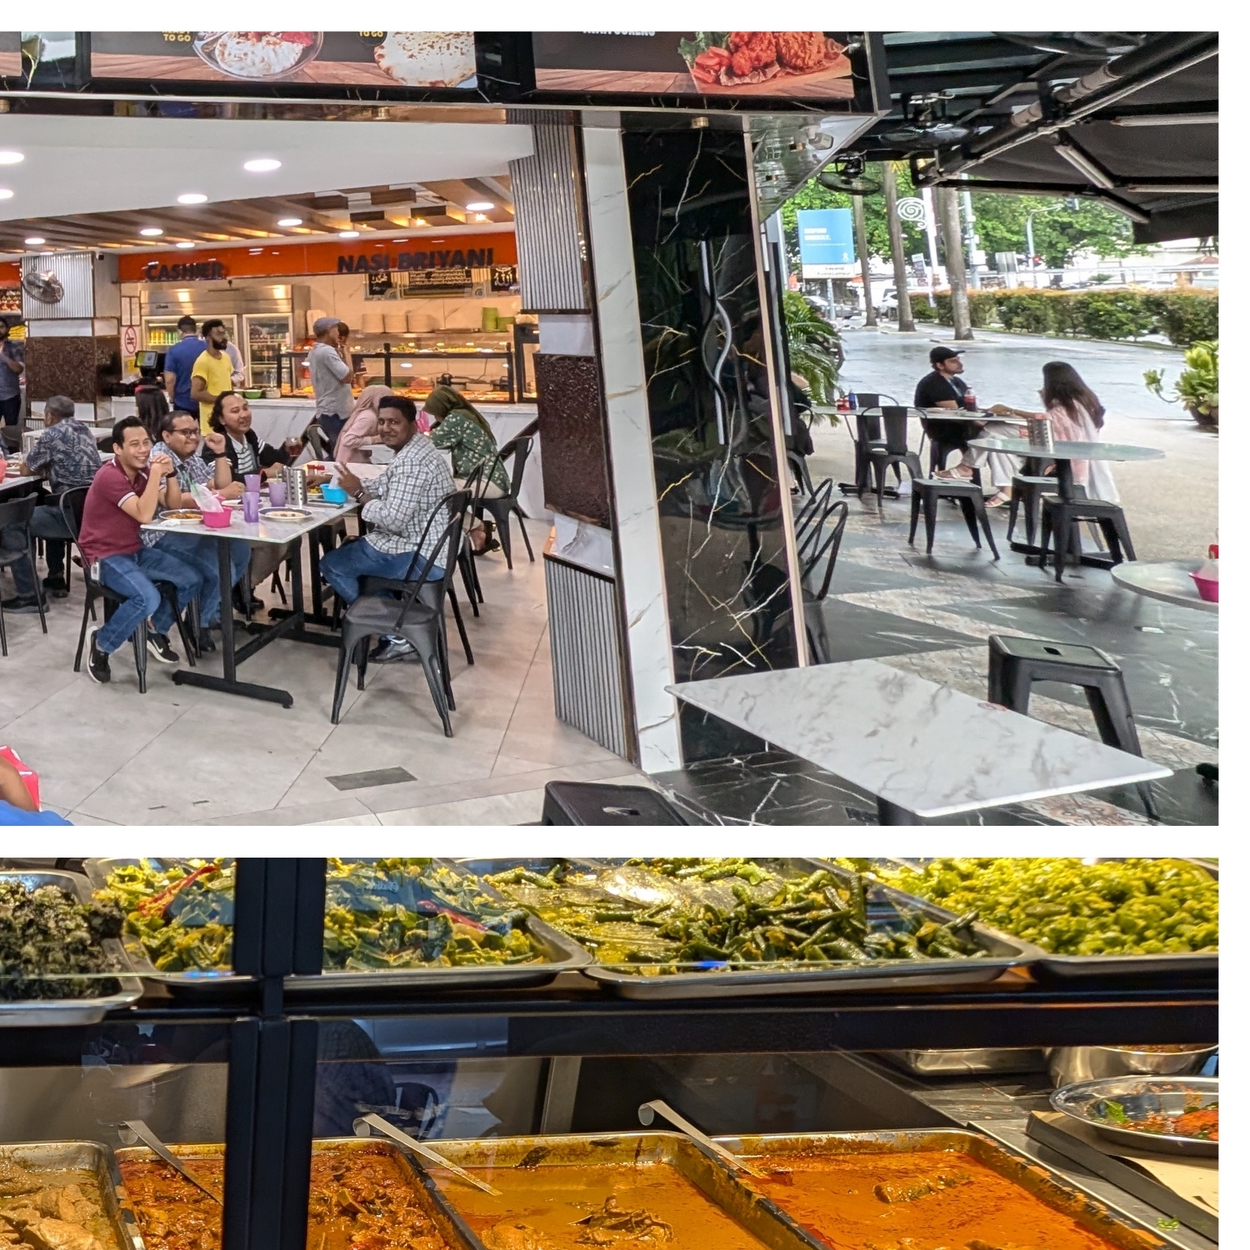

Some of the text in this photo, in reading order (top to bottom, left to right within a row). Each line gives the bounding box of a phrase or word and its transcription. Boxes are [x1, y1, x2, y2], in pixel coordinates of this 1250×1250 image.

[163, 34, 191, 42] TO GO
[338, 247, 494, 273] NASI BRIYANI
[145, 261, 224, 282] CASHIER
